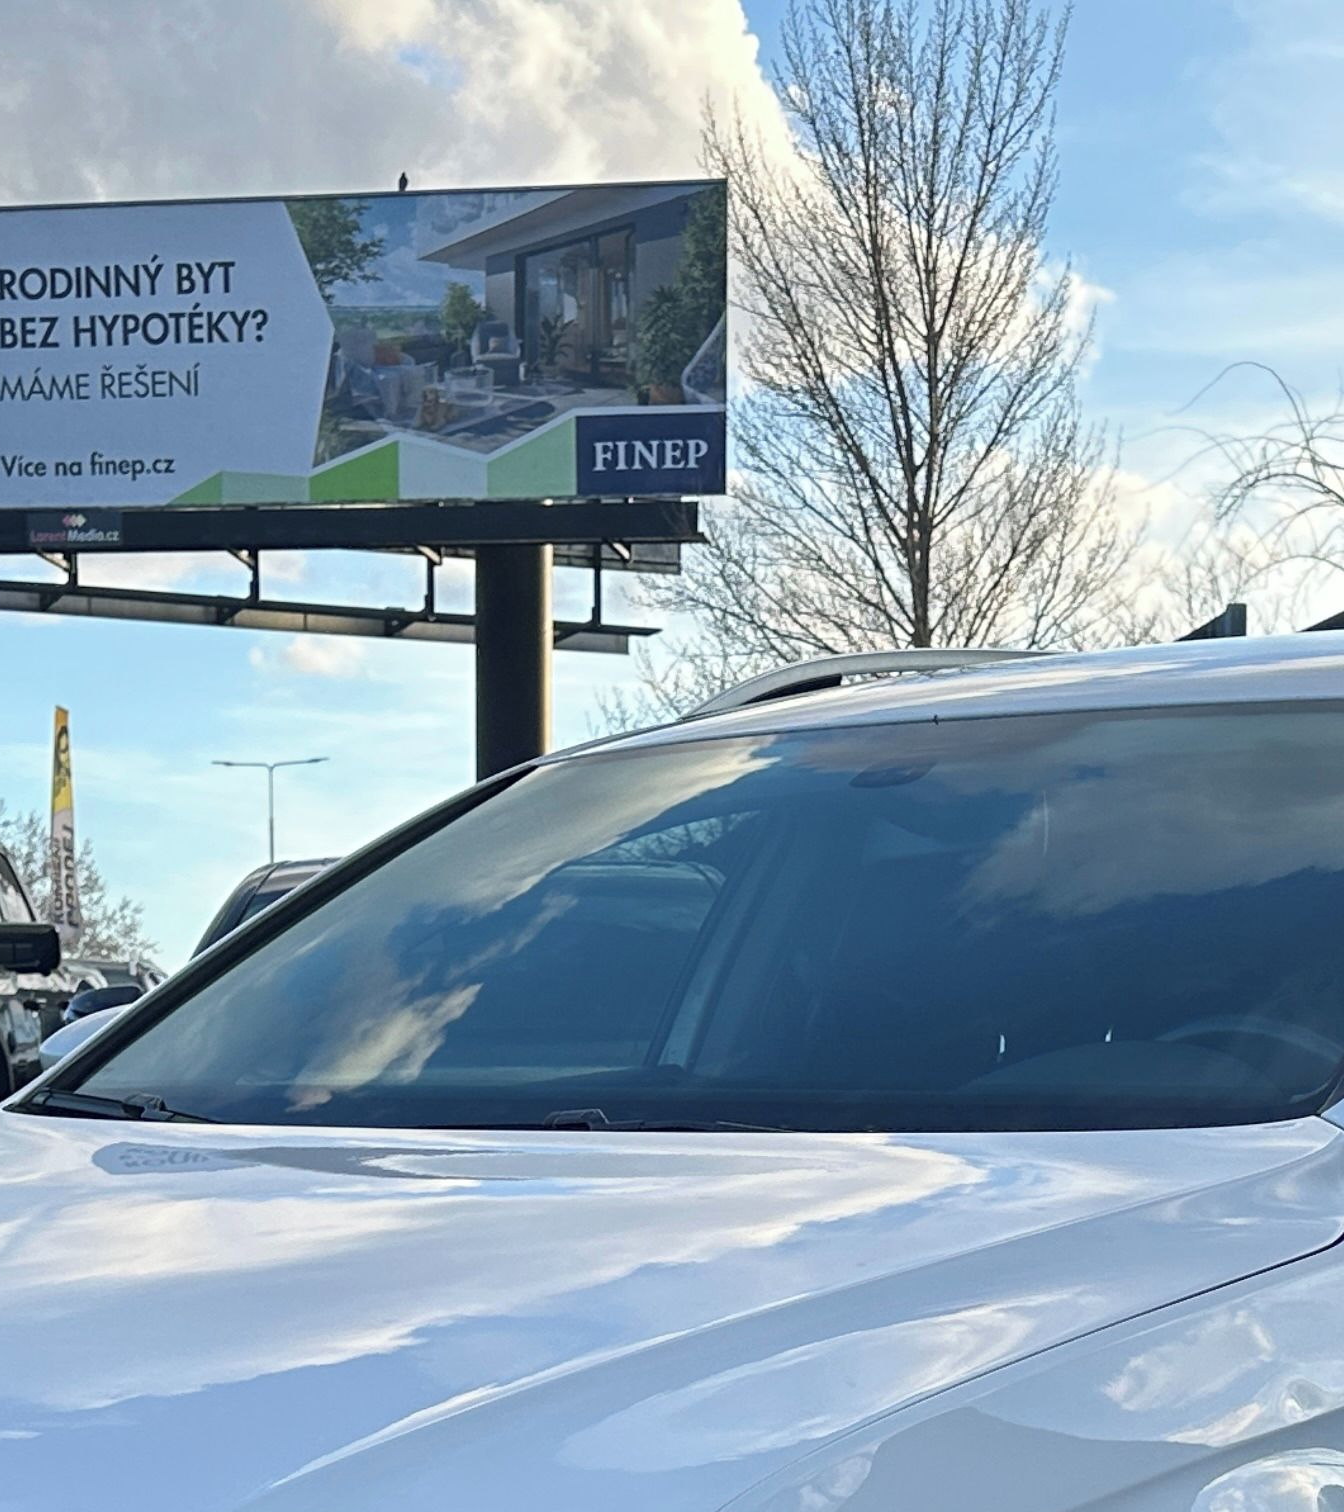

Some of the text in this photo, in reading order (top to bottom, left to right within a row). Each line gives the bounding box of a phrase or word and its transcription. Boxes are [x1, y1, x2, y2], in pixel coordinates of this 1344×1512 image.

[176, 261, 236, 295] BYT
[0, 302, 269, 349] BEZ HYPOTÉKY?
[0, 362, 200, 401] MÁME ŘEŠENÍ
[1, 452, 176, 481] Více na finep.cz
[592, 438, 709, 471] FINEP
